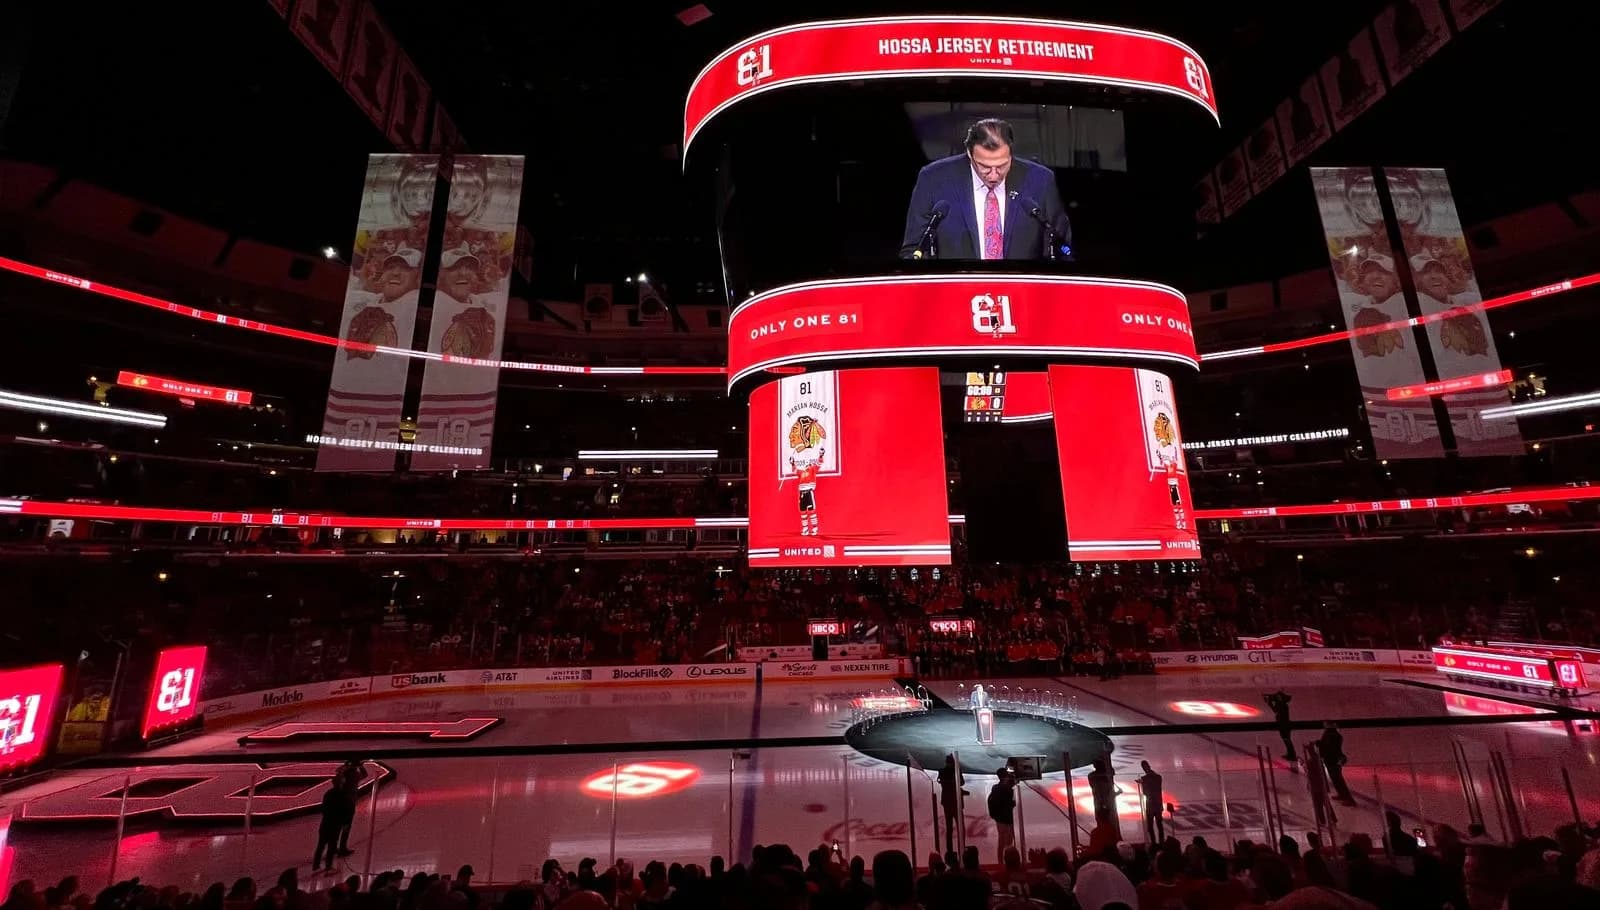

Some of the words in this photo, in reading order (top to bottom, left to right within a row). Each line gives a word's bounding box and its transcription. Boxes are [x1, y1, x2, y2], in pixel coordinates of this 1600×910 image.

[879, 38, 932, 55] HOSSA
[936, 37, 993, 54] JERSEY
[999, 39, 1094, 60] RETIREMENT
[736, 44, 773, 86] 81
[1184, 56, 1209, 99] 81
[971, 294, 1017, 334] 81
[1122, 312, 1163, 326] ONLY
[751, 320, 787, 339] ONLY
[793, 315, 831, 329] ONE
[839, 314, 857, 324] 81
[450, 356, 473, 366] HOSSA
[473, 358, 500, 367] JERSEY
[500, 360, 542, 370] RETIREMENT
[225, 389, 238, 402] 81
[800, 382, 812, 395] 81
[786, 402, 808, 418] MARIAN
[809, 402, 829, 414] HOSSA
[306, 434, 337, 446] HOSSA
[339, 437, 373, 449] JERSEY
[374, 440, 428, 452] RETIREMENT
[429, 444, 483, 456] CELEBRATION
[1206, 439, 1235, 448] JERSEY
[1237, 434, 1287, 446] RETIREMENT
[1289, 428, 1349, 441] CELEBRATION
[1400, 500, 1411, 509] 81
[272, 514, 283, 524] 81
[785, 548, 821, 556] UNITED
[1200, 654, 1239, 662] HYUNDAI
[612, 669, 659, 680] BlockFills
[702, 667, 747, 676] LEXUS
[844, 664, 870, 672] NEXEN
[872, 663, 890, 671] TIRE
[495, 672, 518, 682] AT&T
[157, 668, 195, 713] 81
[262, 690, 304, 707] Modelo
